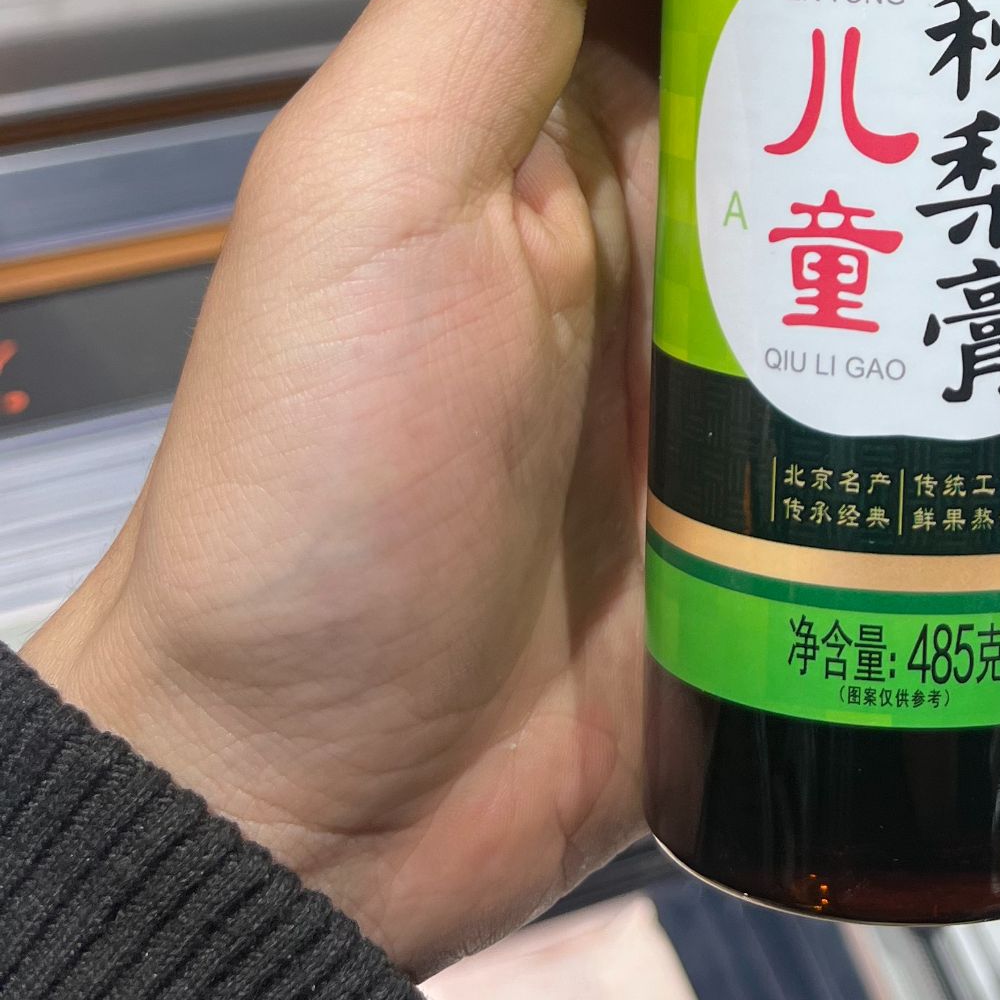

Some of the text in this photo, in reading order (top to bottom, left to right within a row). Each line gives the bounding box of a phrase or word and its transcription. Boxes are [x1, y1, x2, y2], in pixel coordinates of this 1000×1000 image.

[764, 26, 919, 333] 儿童
[723, 189, 748, 230] A
[764, 347, 906, 381] QIU LI GAO
[783, 463, 891, 495] 北京名产
[783, 497, 890, 529] 传承经典
[839, 684, 951, 708] (图案仅供参考)
